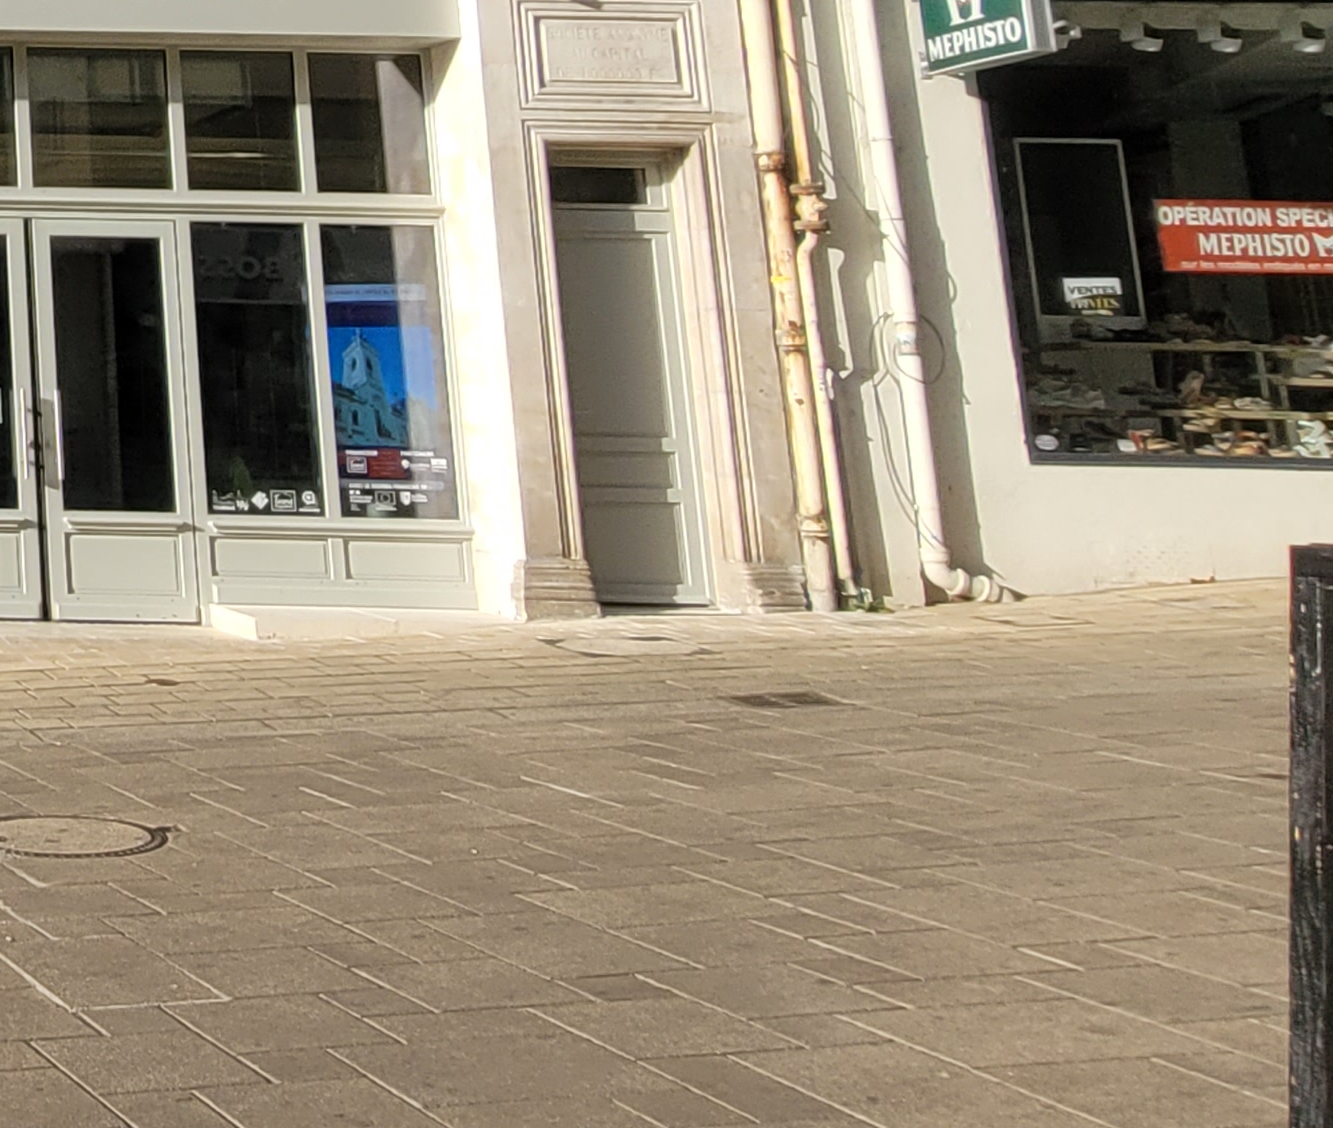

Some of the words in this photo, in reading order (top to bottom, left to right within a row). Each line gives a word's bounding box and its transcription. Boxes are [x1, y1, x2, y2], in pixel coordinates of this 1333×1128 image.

[927, 17, 1022, 62] MEPHISTO
[1158, 202, 1273, 227] OPÉRATION
[1197, 233, 1310, 257] MEPHISTO
[1067, 285, 1118, 296] VENTES
